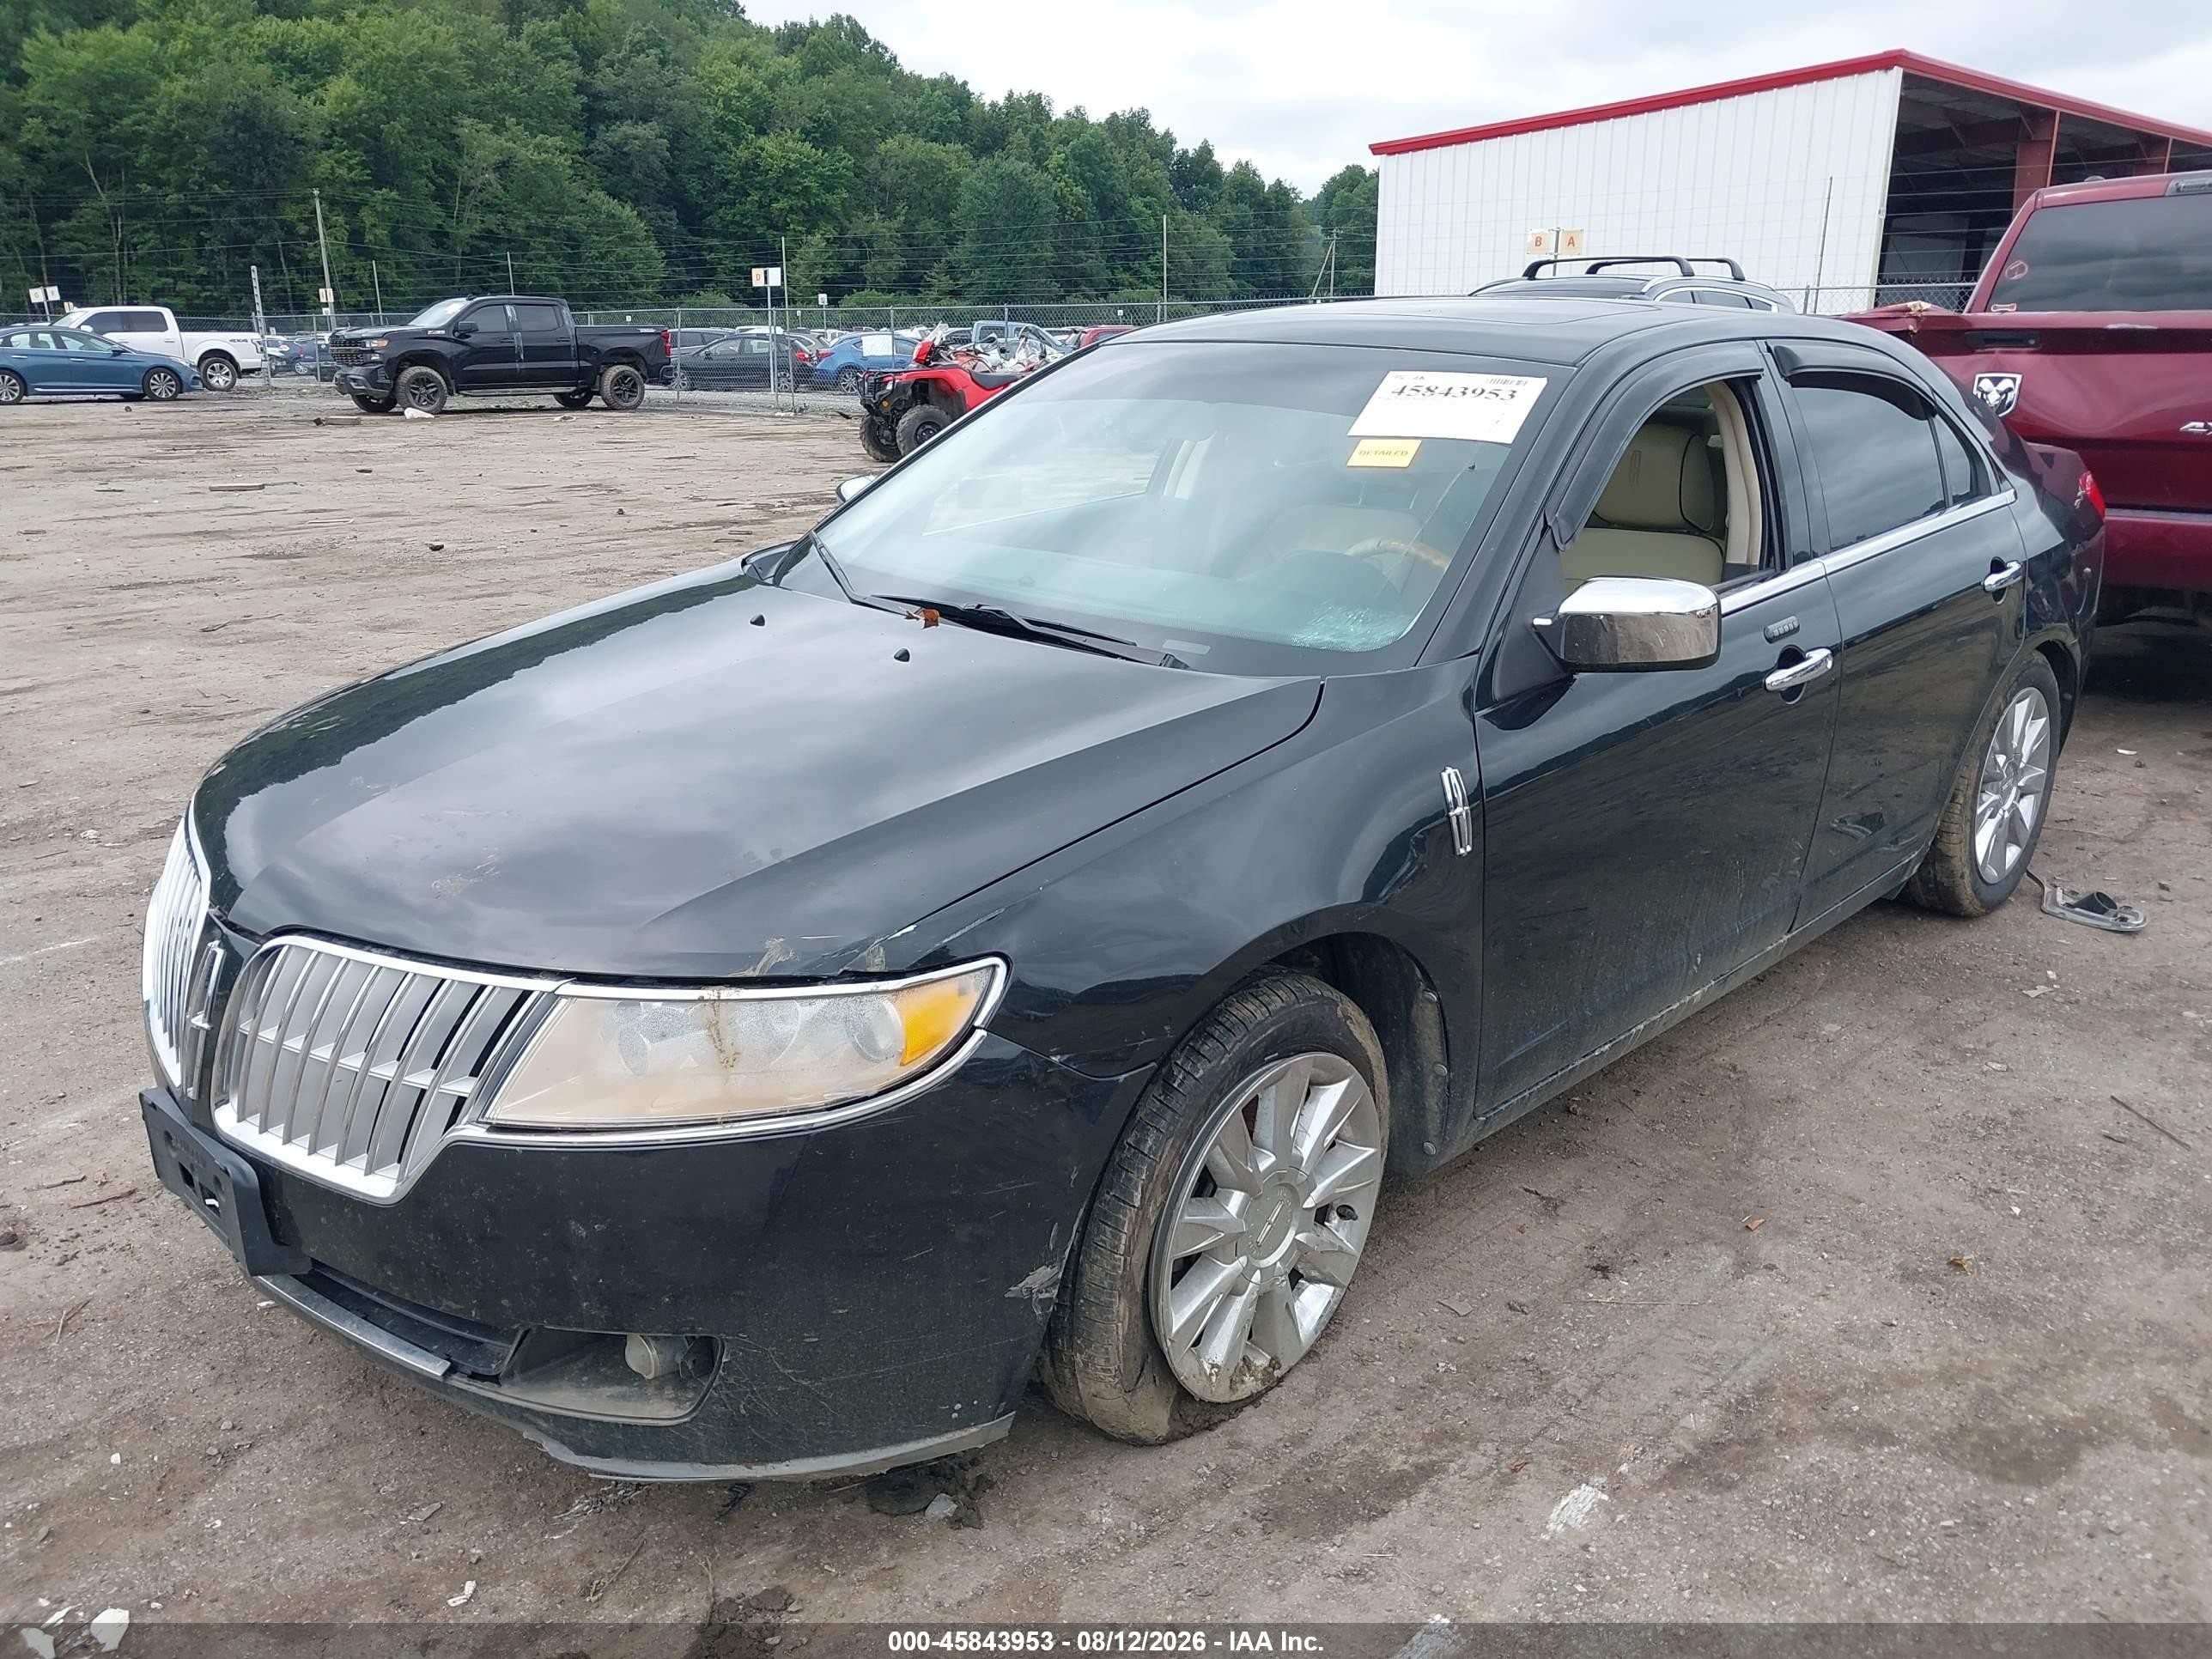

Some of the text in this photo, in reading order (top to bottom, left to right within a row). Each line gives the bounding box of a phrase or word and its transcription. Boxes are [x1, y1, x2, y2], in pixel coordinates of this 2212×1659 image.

[1534, 235, 1543, 247] B
[1566, 235, 1577, 247] A
[755, 273, 762, 282] D
[1391, 384, 1519, 401] 45843953
